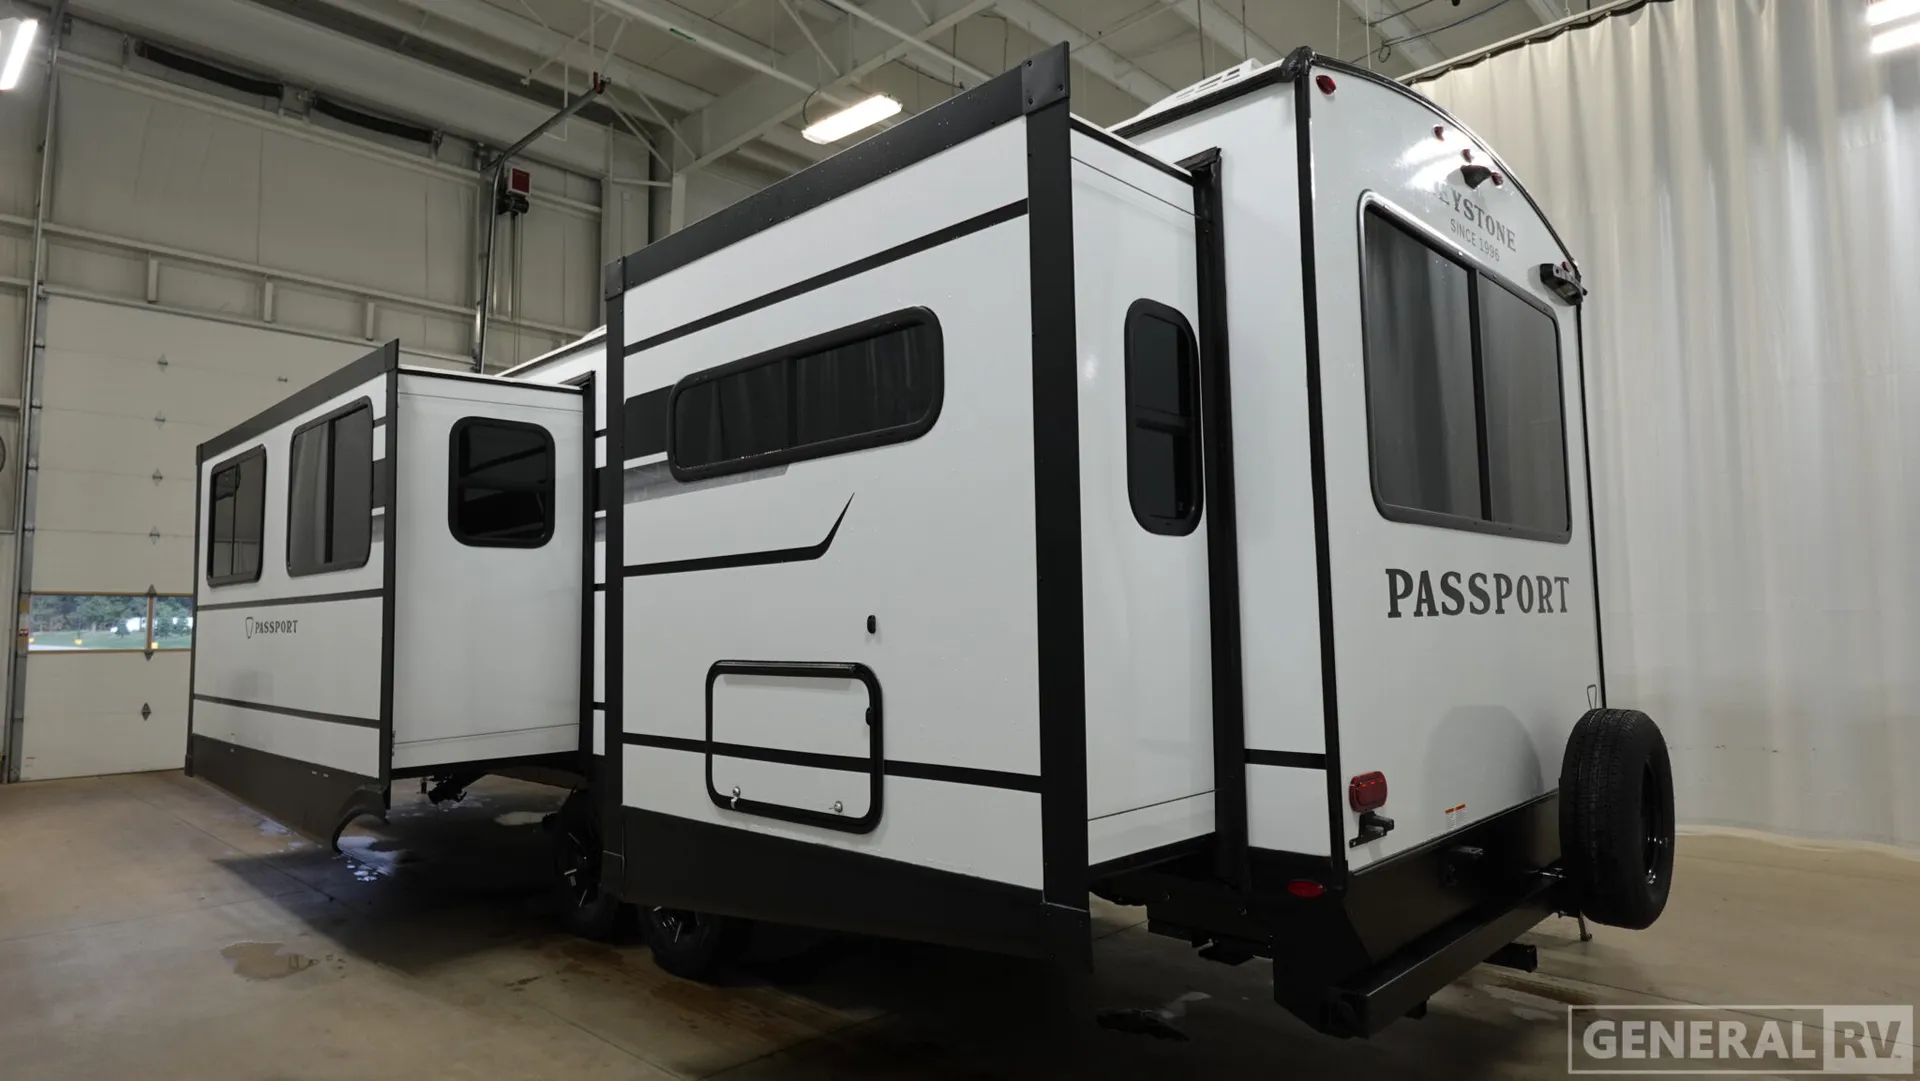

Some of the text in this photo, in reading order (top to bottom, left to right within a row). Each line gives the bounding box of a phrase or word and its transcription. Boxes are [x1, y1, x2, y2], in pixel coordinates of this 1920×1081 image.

[1431, 181, 1517, 253] EYSTONE
[1450, 218, 1500, 262] SINCE 1996
[1385, 568, 1569, 618] PASSPORT
[255, 619, 298, 634] PASSPORT
